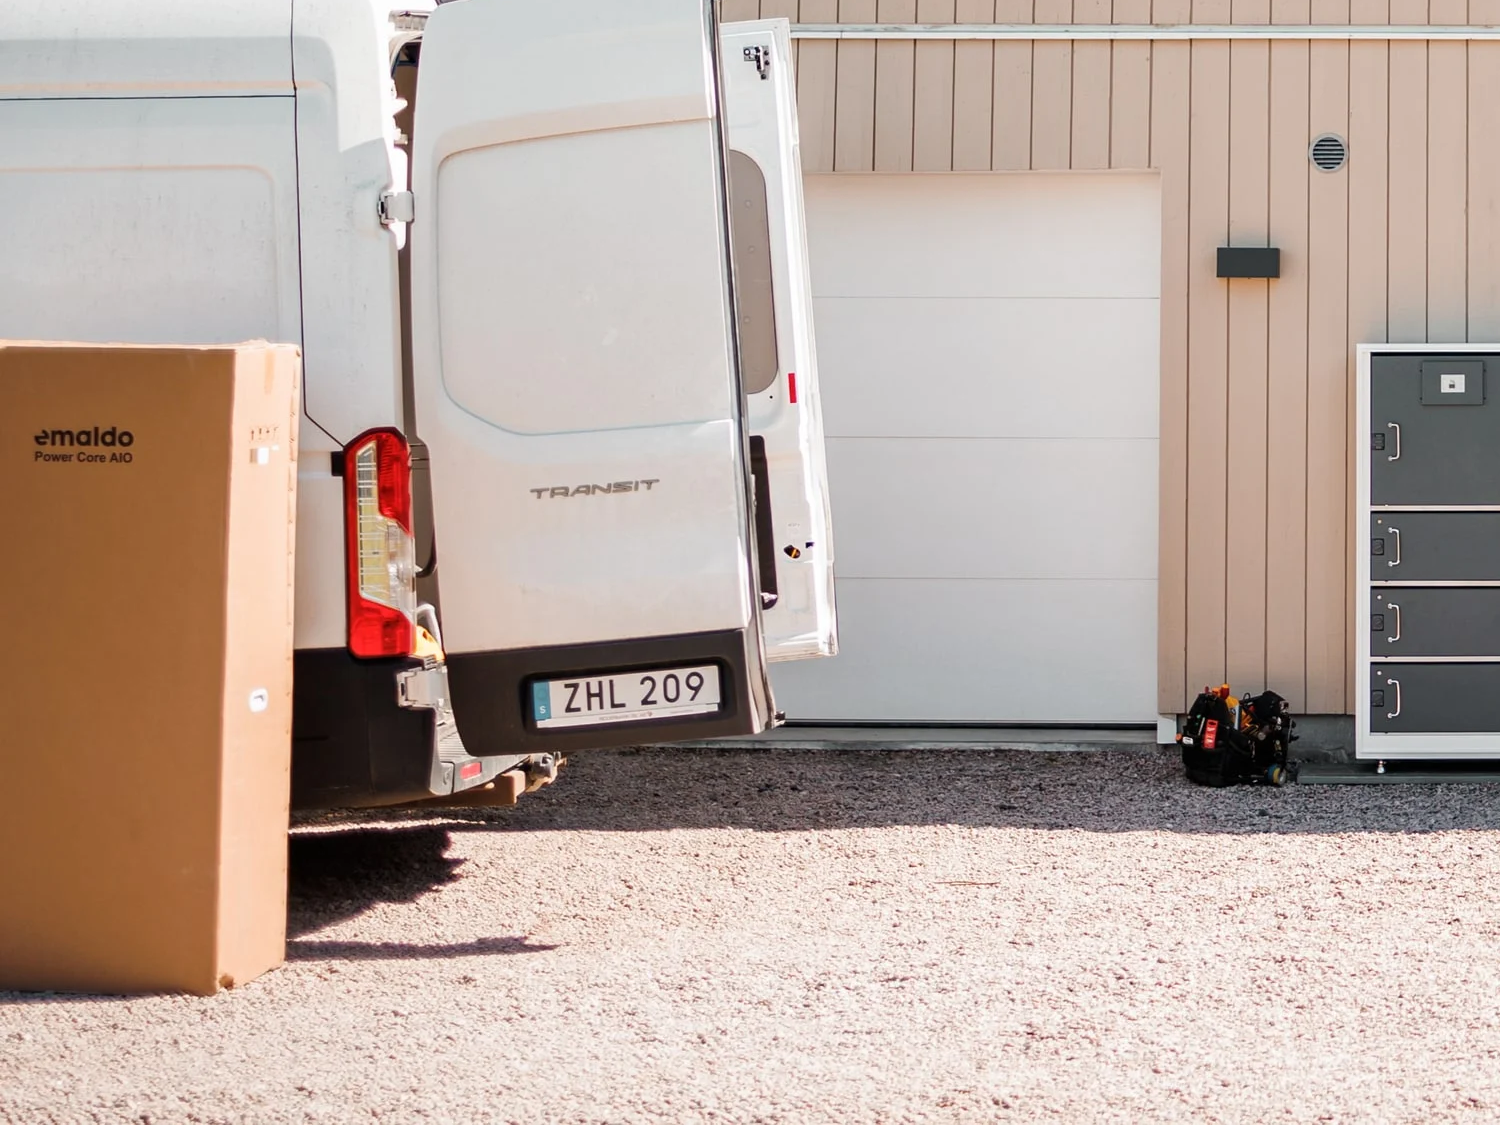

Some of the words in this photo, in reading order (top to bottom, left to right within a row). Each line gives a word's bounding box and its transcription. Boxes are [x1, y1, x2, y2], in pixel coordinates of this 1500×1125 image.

[34, 426, 135, 447] emaldo
[34, 451, 73, 463] Power
[77, 452, 106, 463] Core
[529, 478, 660, 500] TRANSIT
[563, 679, 626, 713] ZHL
[639, 671, 704, 706] 209
[539, 705, 546, 714] S
